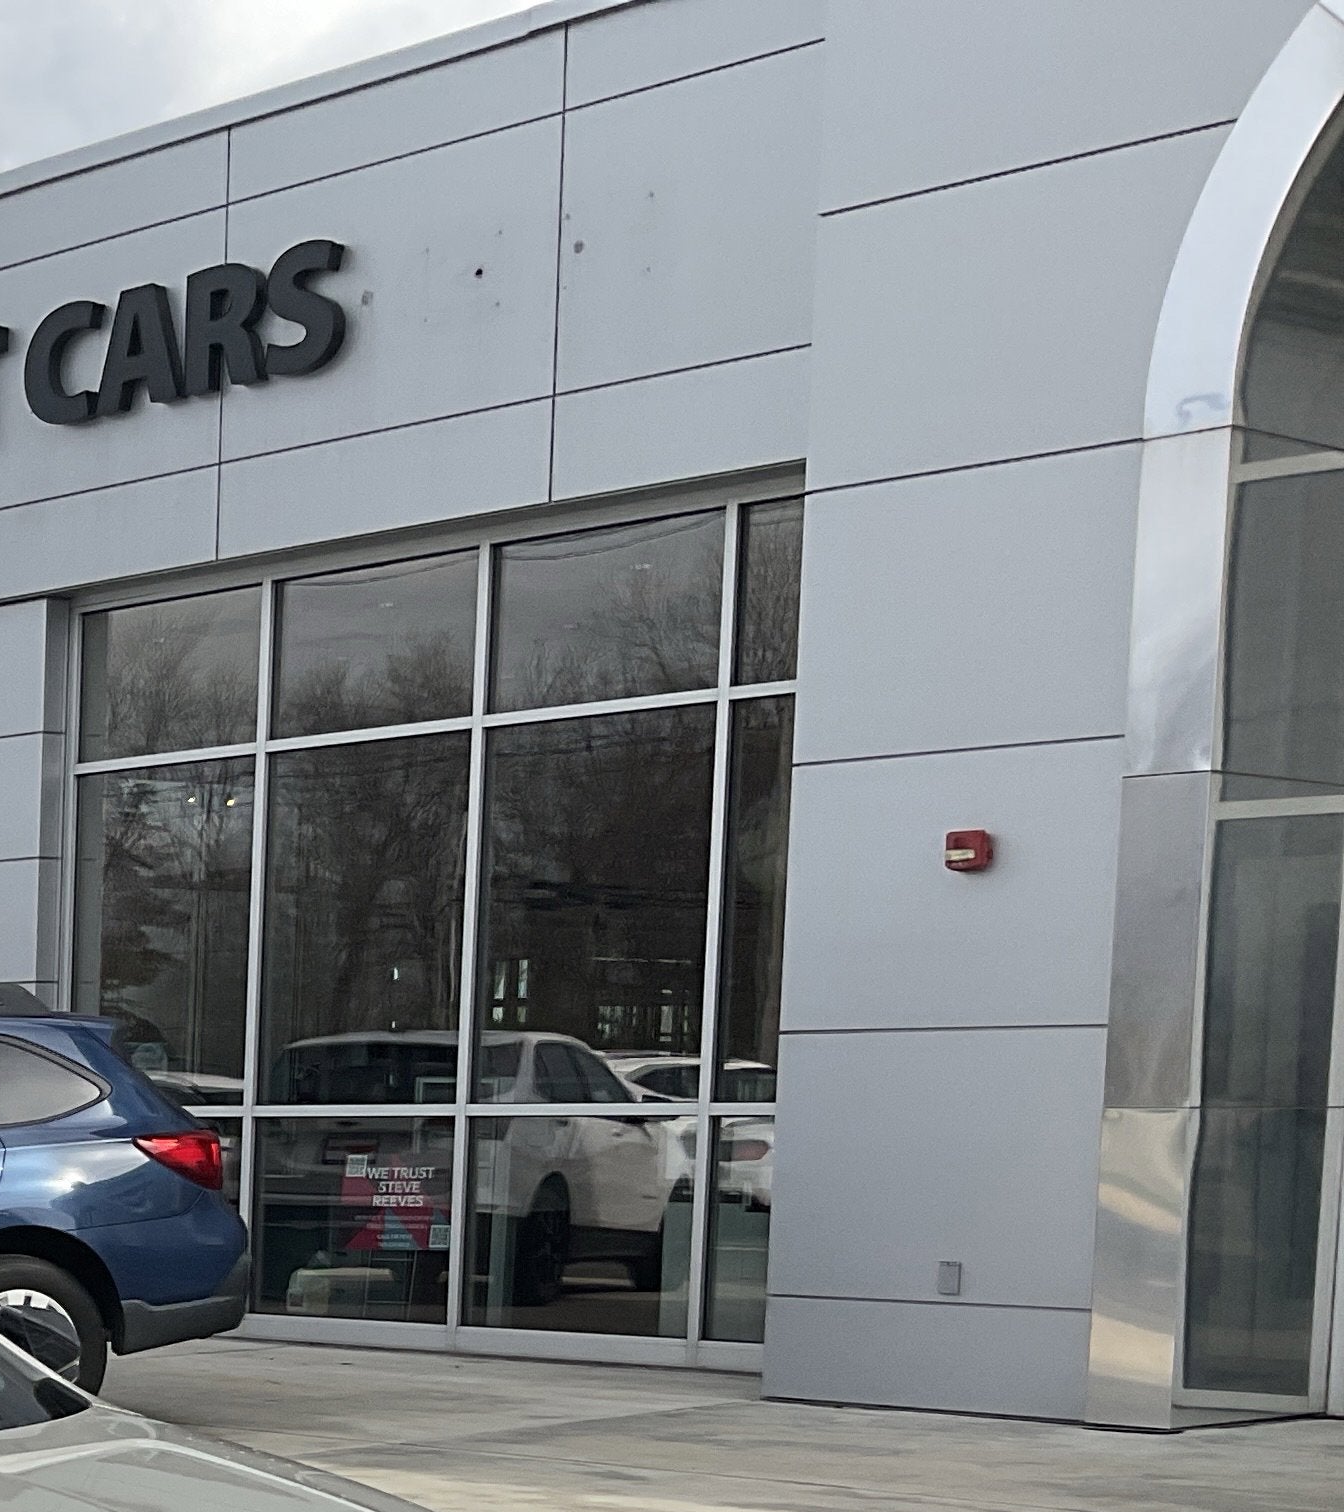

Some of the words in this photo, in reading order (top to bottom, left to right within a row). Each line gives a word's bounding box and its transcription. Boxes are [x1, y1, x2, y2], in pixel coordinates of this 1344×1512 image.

[24, 238, 347, 426] CARS
[367, 1167, 389, 1179] WE
[392, 1167, 435, 1179] TRUST
[378, 1181, 421, 1193] STEVE
[372, 1195, 424, 1207] REEVES
